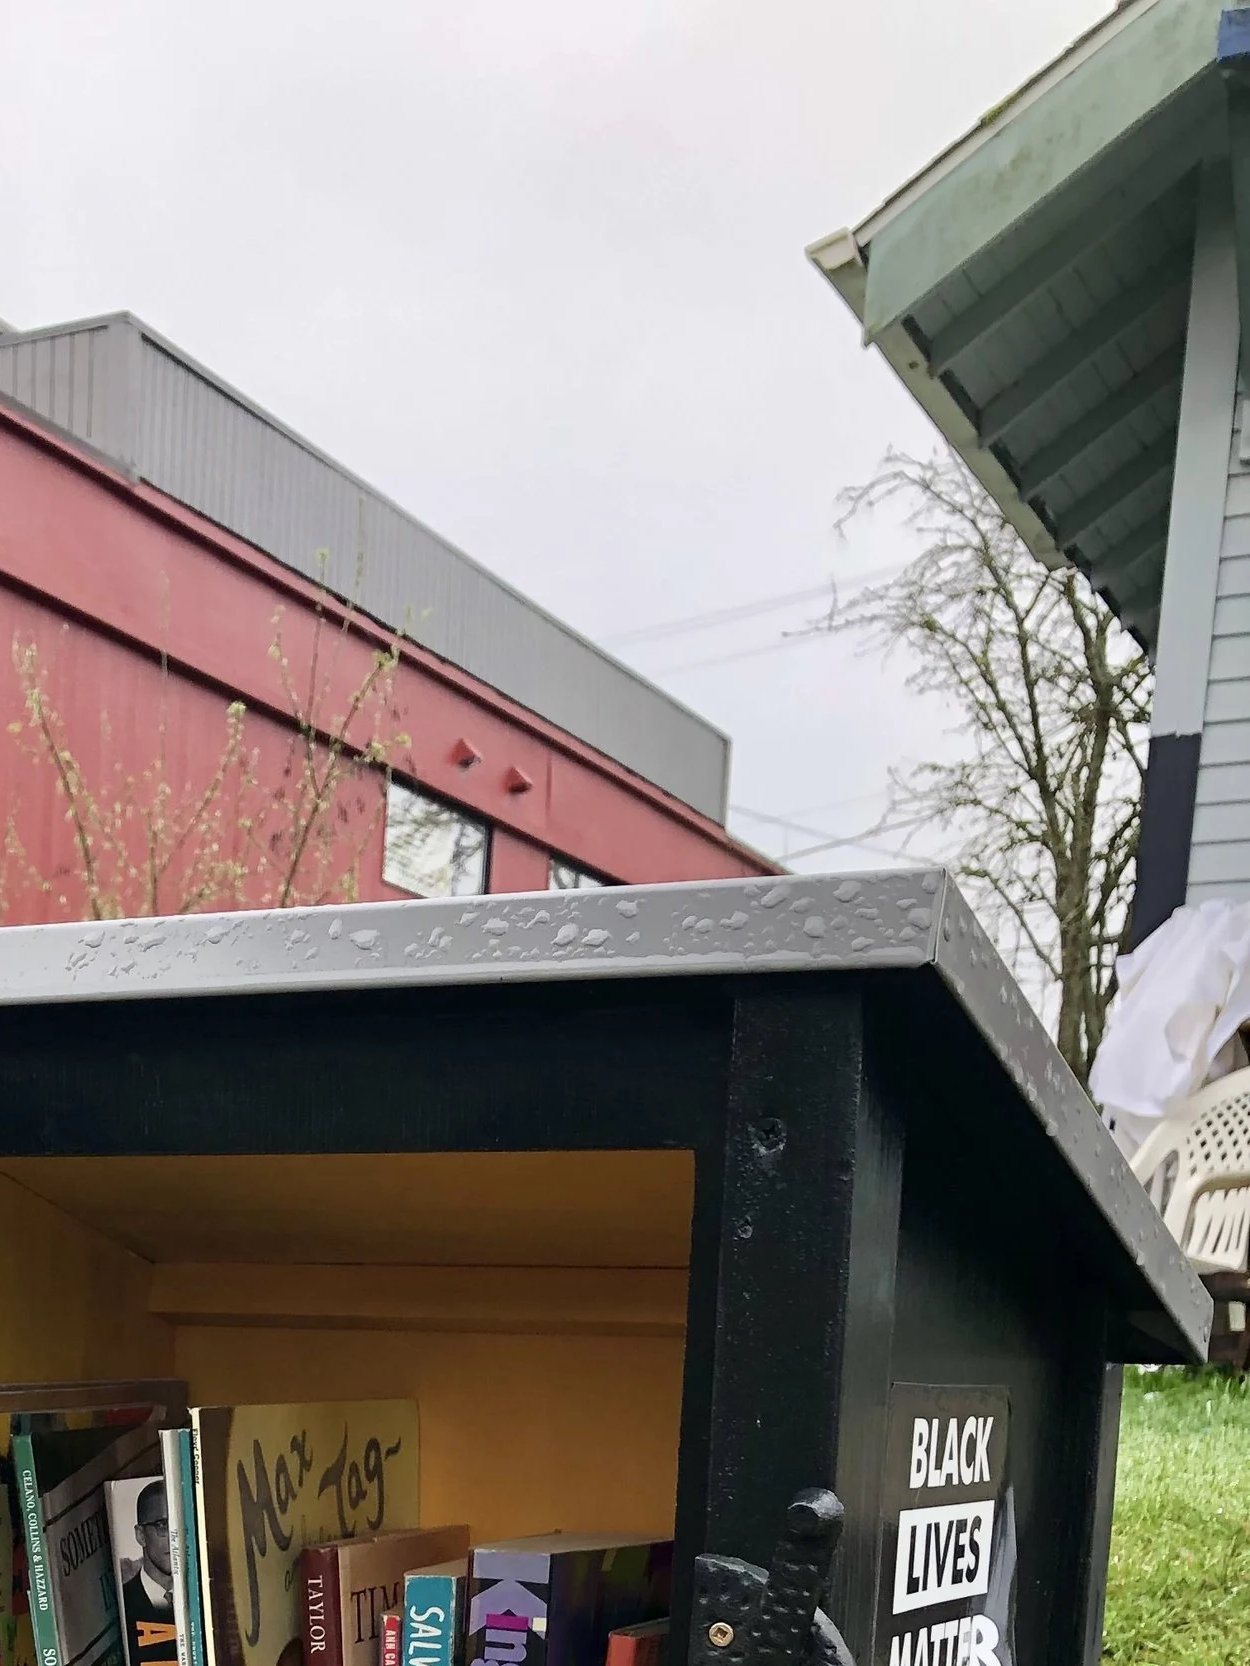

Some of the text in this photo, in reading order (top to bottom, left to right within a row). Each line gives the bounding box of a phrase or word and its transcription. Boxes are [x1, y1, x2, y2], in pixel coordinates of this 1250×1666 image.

[908, 1415, 995, 1490] BLACK
[22, 1469, 49, 1612] CELANO, COLLINS & HAZZARD
[60, 1511, 110, 1577] SOMET
[236, 1429, 313, 1648] Max
[905, 1514, 982, 1596] LIVES
[307, 1575, 327, 1654] TAYLOR
[387, 1629, 396, 1652] ANN
